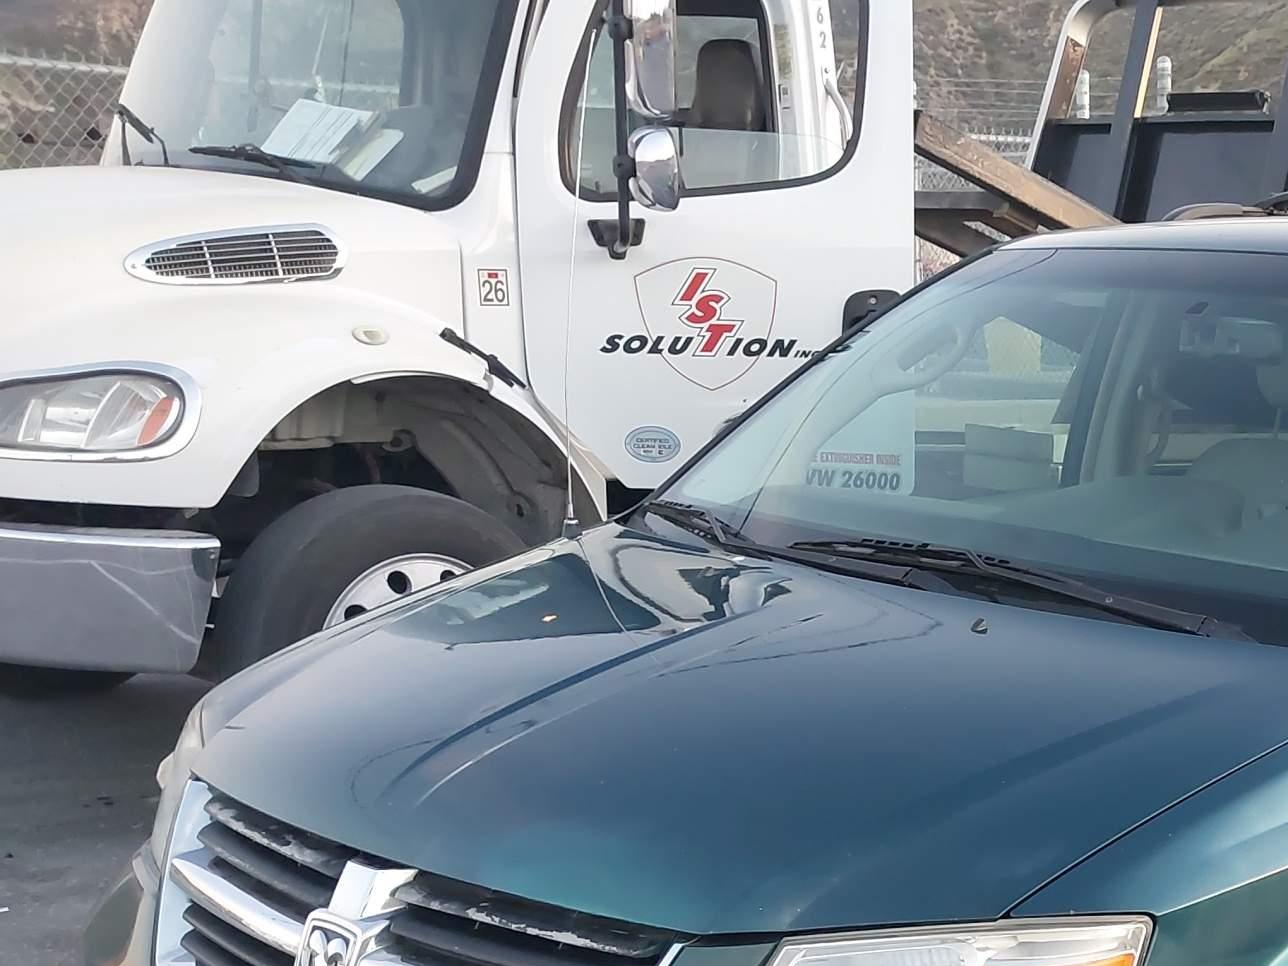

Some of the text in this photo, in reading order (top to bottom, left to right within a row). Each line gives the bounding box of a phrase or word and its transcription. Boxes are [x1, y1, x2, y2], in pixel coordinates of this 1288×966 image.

[481, 280, 506, 303] 26
[599, 333, 797, 358] SOLUTION
[840, 470, 901, 491] 26000
